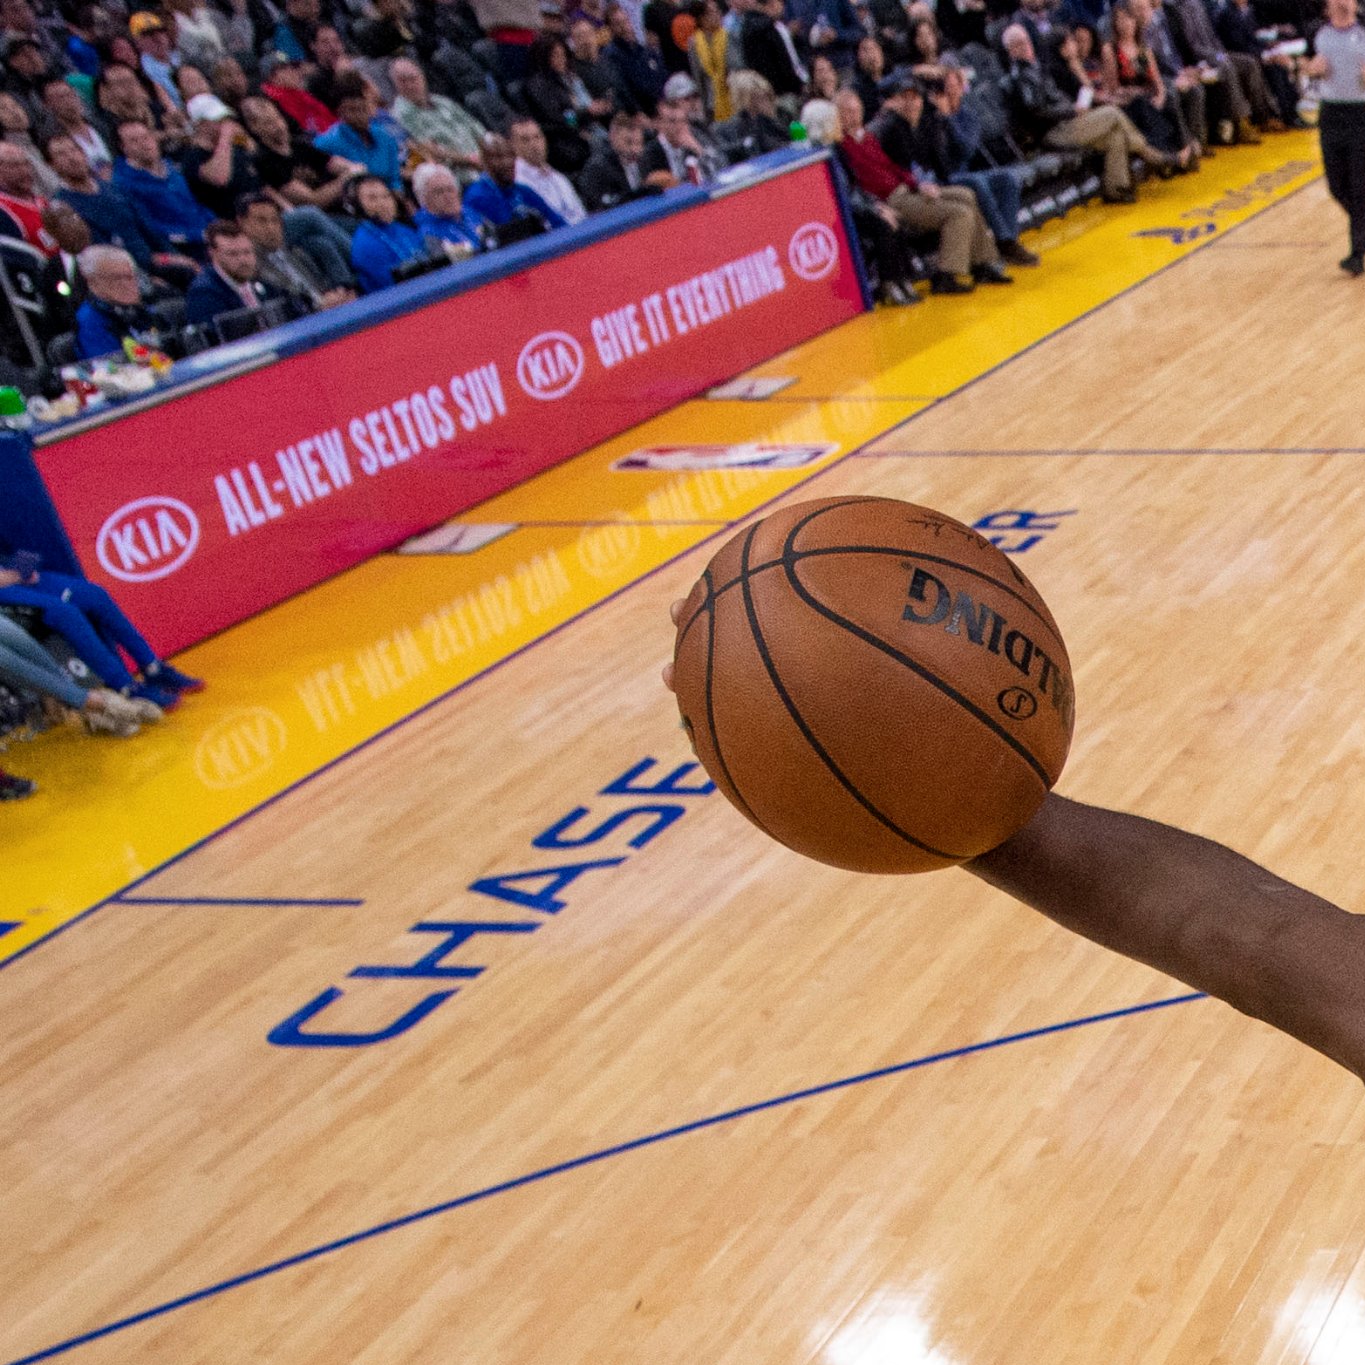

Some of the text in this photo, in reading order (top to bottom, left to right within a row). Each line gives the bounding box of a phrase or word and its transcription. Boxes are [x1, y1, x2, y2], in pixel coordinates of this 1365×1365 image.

[107, 507, 191, 573] KIA
[214, 427, 353, 537] ALL-NEW
[348, 392, 456, 476] SELTOS
[449, 361, 507, 432] SUV
[522, 338, 579, 393] KIA
[590, 303, 649, 369] GIVE
[641, 293, 671, 348] IT
[665, 244, 787, 336] EVERYTHING
[266, 757, 718, 1047] CHASE
